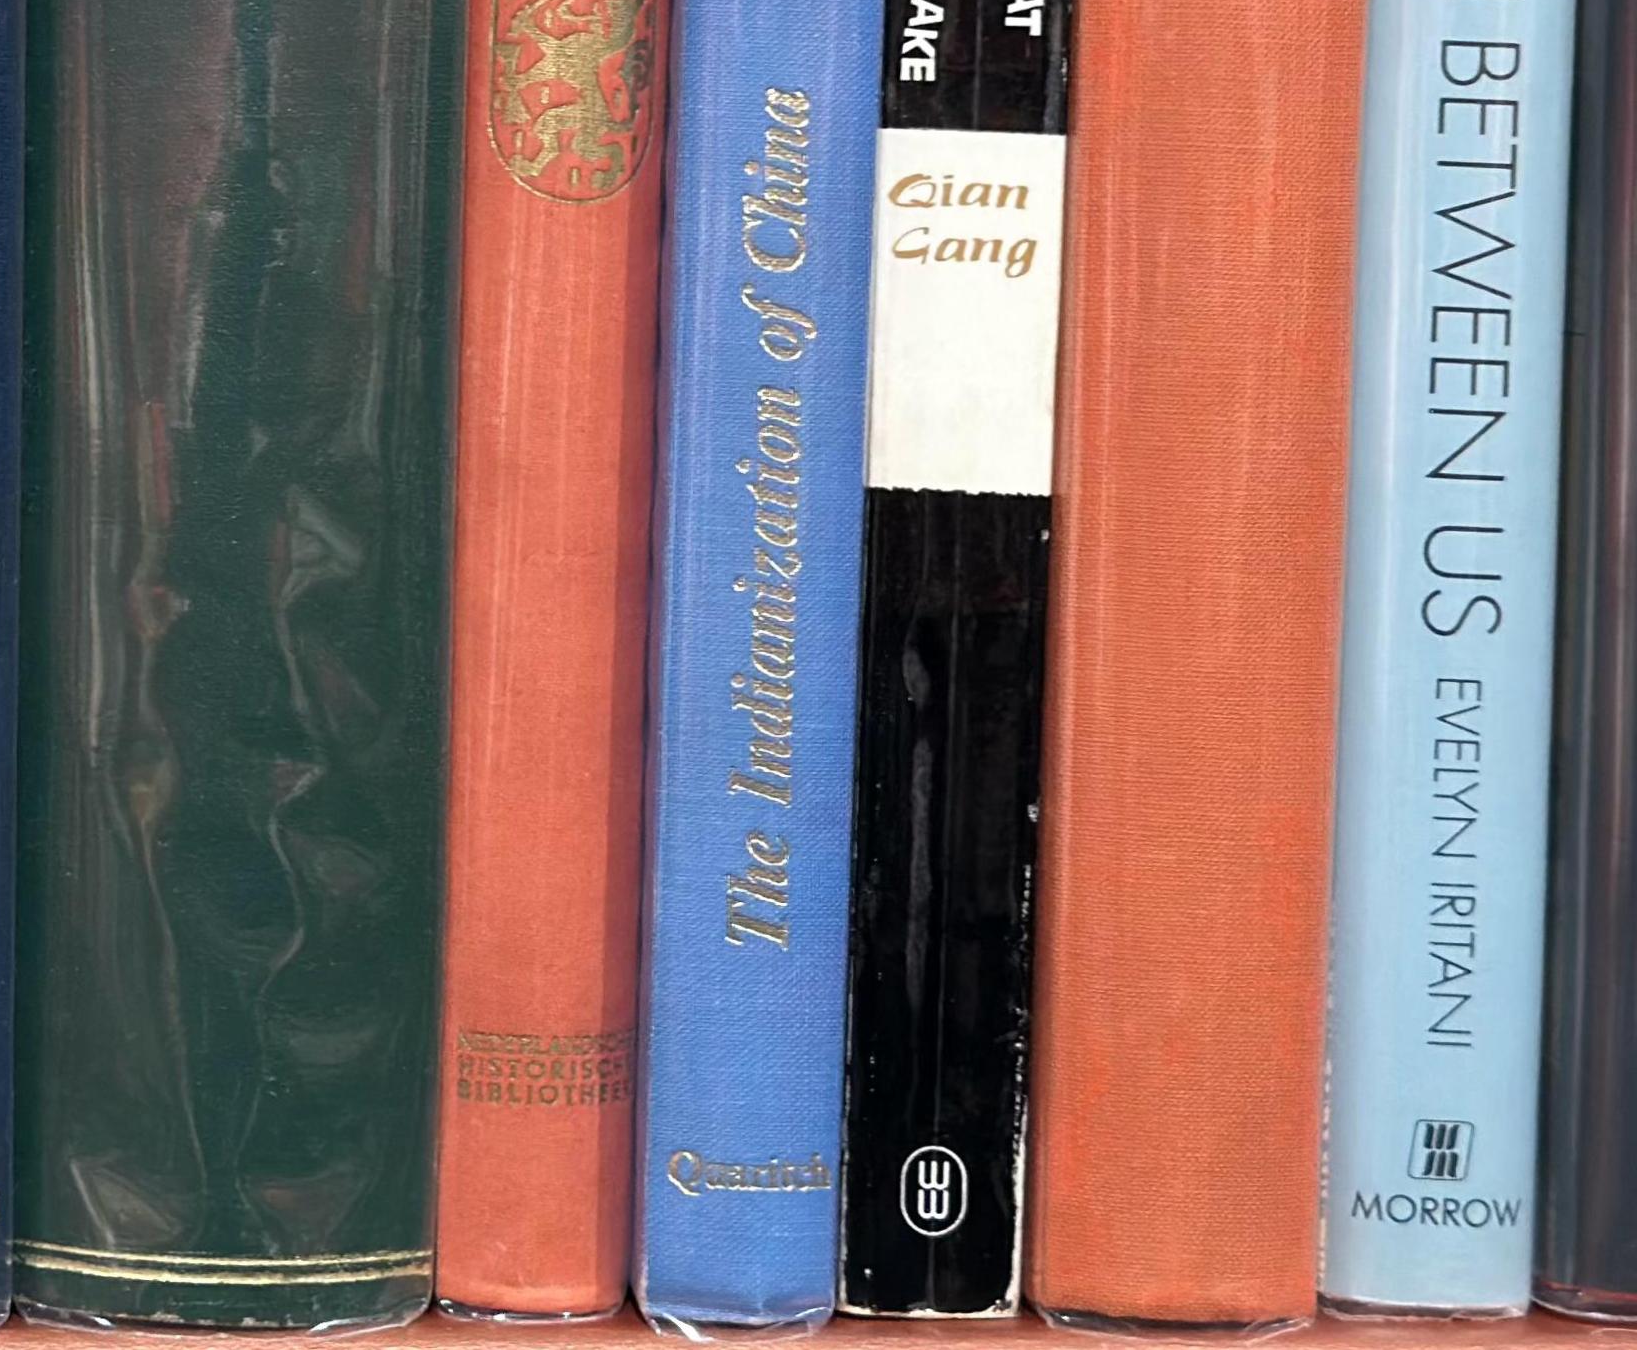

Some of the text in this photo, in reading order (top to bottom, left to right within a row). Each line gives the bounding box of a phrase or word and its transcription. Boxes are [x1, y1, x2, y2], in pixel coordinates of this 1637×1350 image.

[887, 174, 1028, 210] Qian
[891, 227, 1037, 278] Gang
[1424, 40, 1523, 483] BETWEEN
[724, 86, 820, 952] The Indianization of China
[1421, 526, 1504, 638] US
[1426, 676, 1482, 1049] EVELYN IRITANI
[668, 1151, 831, 1196] Quaritch
[1350, 1191, 1521, 1229] MORROW
